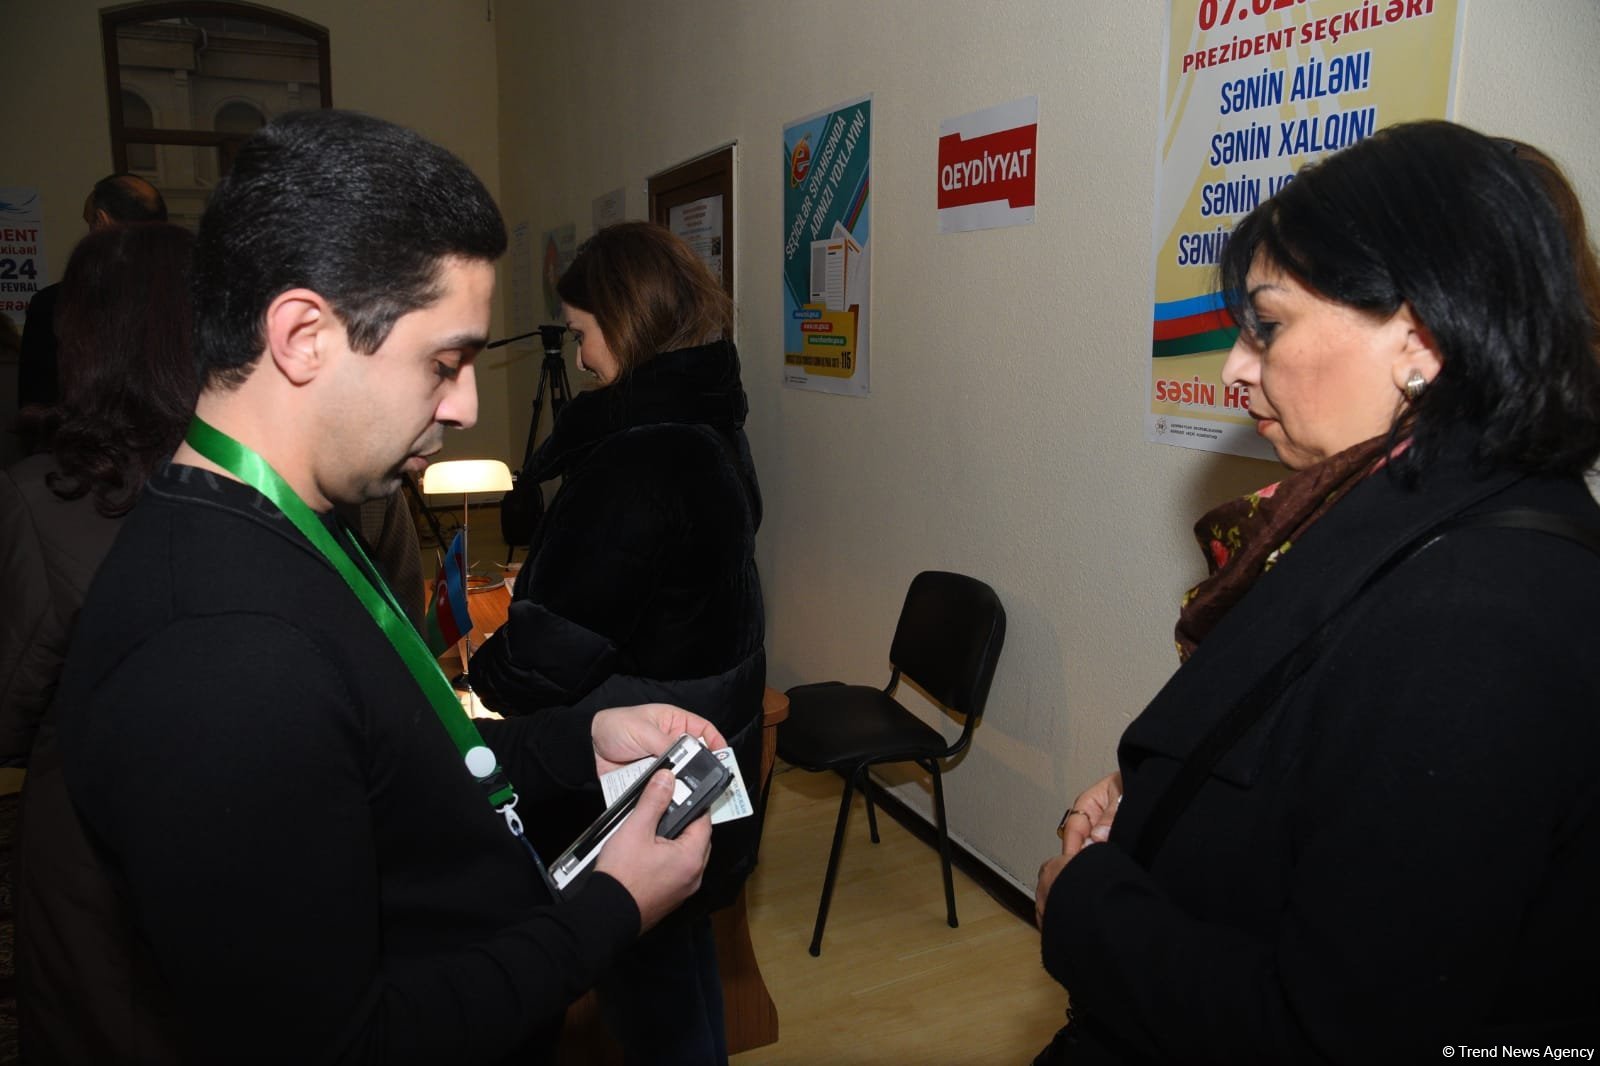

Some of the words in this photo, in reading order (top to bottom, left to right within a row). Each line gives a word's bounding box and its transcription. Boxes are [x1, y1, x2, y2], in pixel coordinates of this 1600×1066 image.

[1182, 27, 1297, 73] PREZİDENT
[1220, 68, 1284, 115] SƏNİN
[1290, 52, 1370, 102] AİLƏN!
[809, 115, 847, 198] SİYAHISINDA
[1210, 122, 1271, 166] SƏNİN
[810, 184, 835, 241] ADINIZI
[829, 109, 866, 188] YOXLAYIN!
[941, 148, 1032, 191] QEYDİYYAT
[1201, 174, 1260, 216] SƏNİN
[1, 282, 38, 293] FEVRAL
[841, 351, 851, 370] 115
[1156, 376, 1215, 406] SƏSİN
